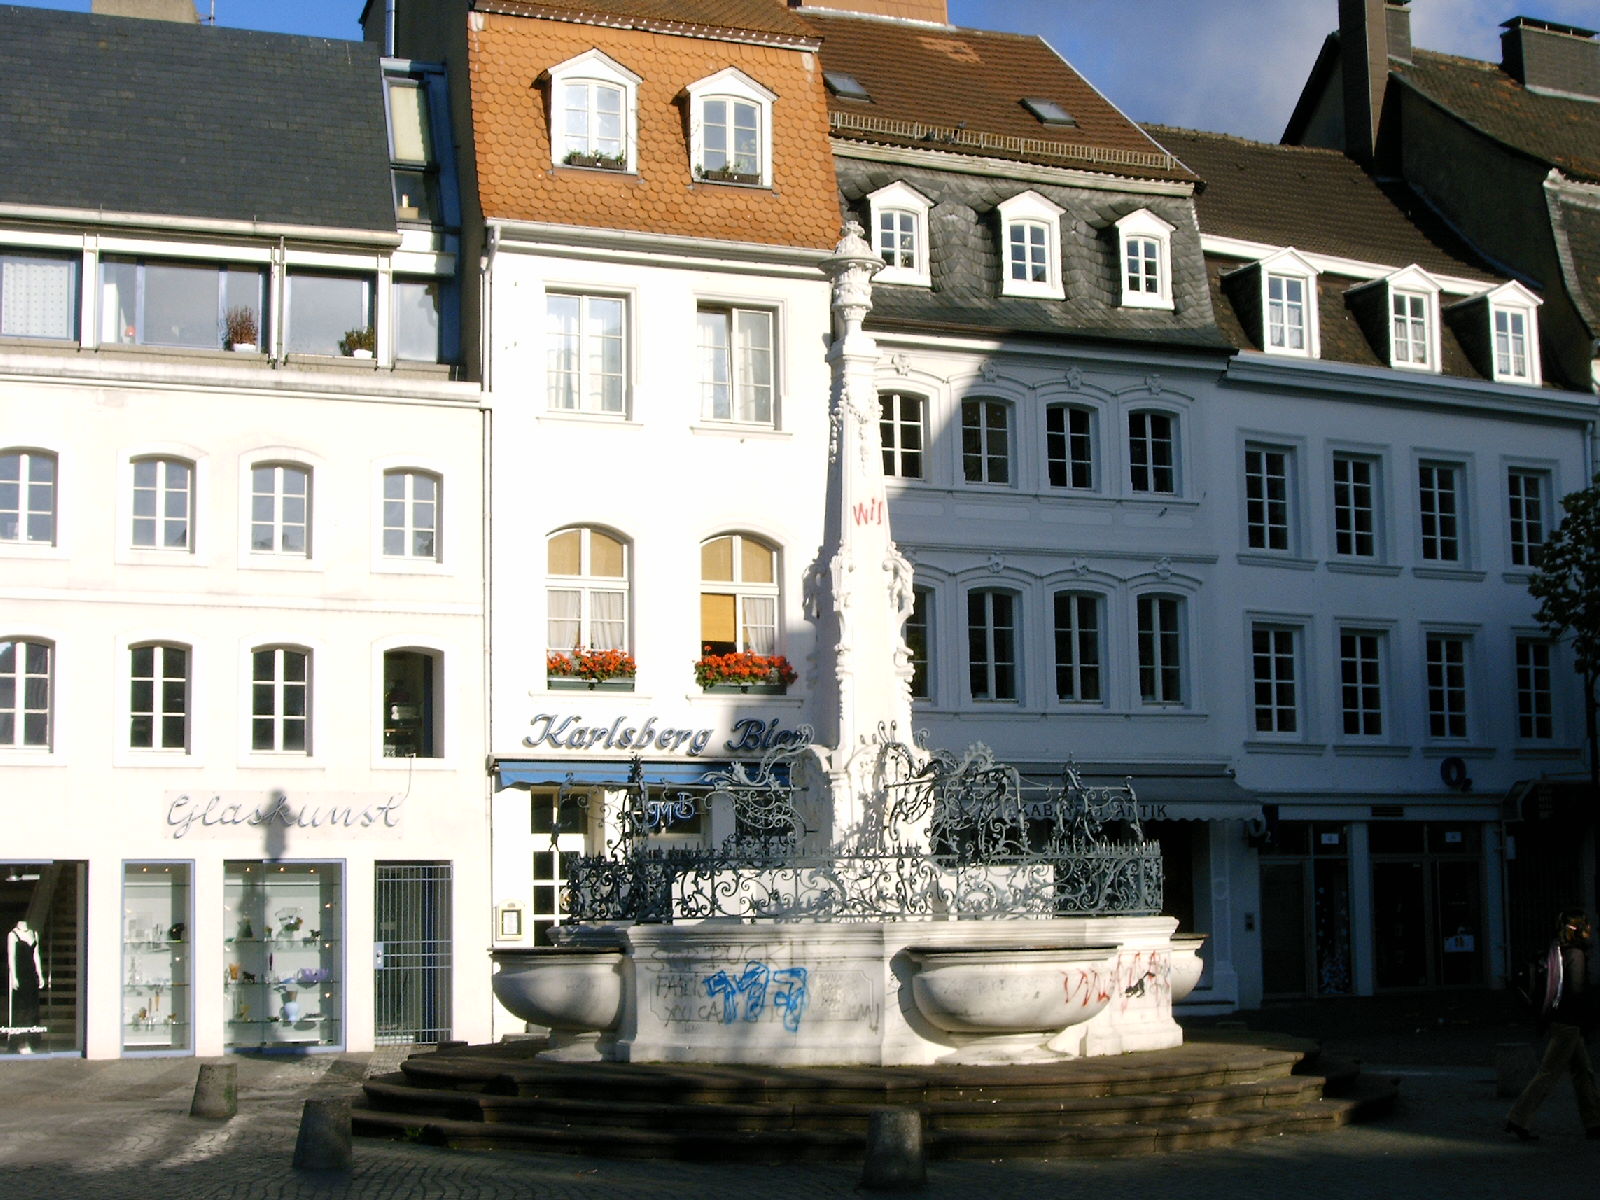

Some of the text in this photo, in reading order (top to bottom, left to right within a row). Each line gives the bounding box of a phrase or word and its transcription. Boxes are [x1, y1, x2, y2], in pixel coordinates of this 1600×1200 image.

[523, 713, 714, 756] Karlsberg
[167, 795, 402, 839] Glaskunst
[1115, 804, 1167, 817] ANTIK
